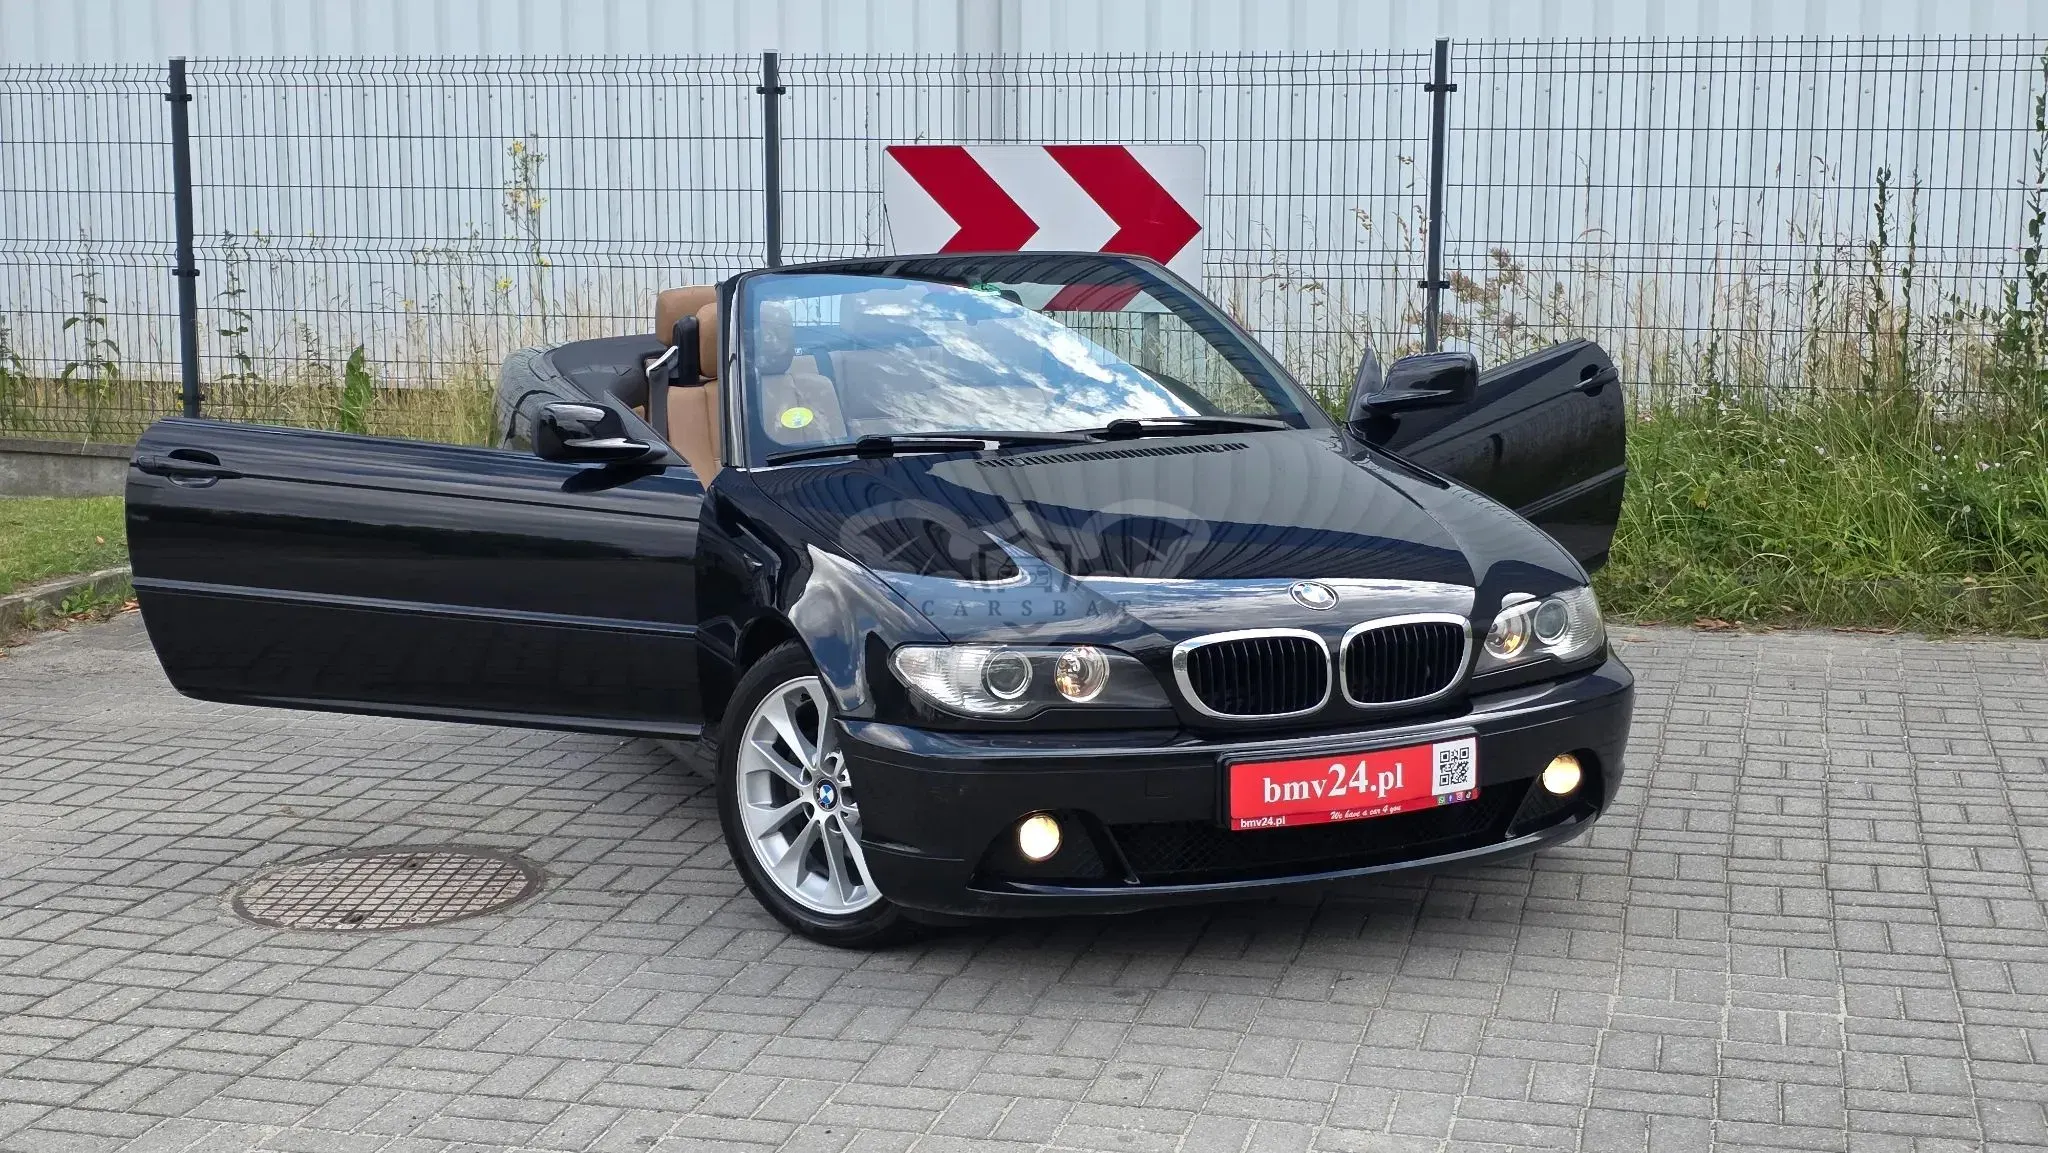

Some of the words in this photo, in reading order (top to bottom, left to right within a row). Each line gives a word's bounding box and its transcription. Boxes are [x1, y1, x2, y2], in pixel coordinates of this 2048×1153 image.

[1263, 760, 1404, 804] bmv24.pl
[1330, 811, 1343, 819] We
[1344, 809, 1360, 818] have
[1382, 804, 1388, 812] 4
[1389, 805, 1401, 814] you
[1240, 816, 1286, 828] bmv24.pl
